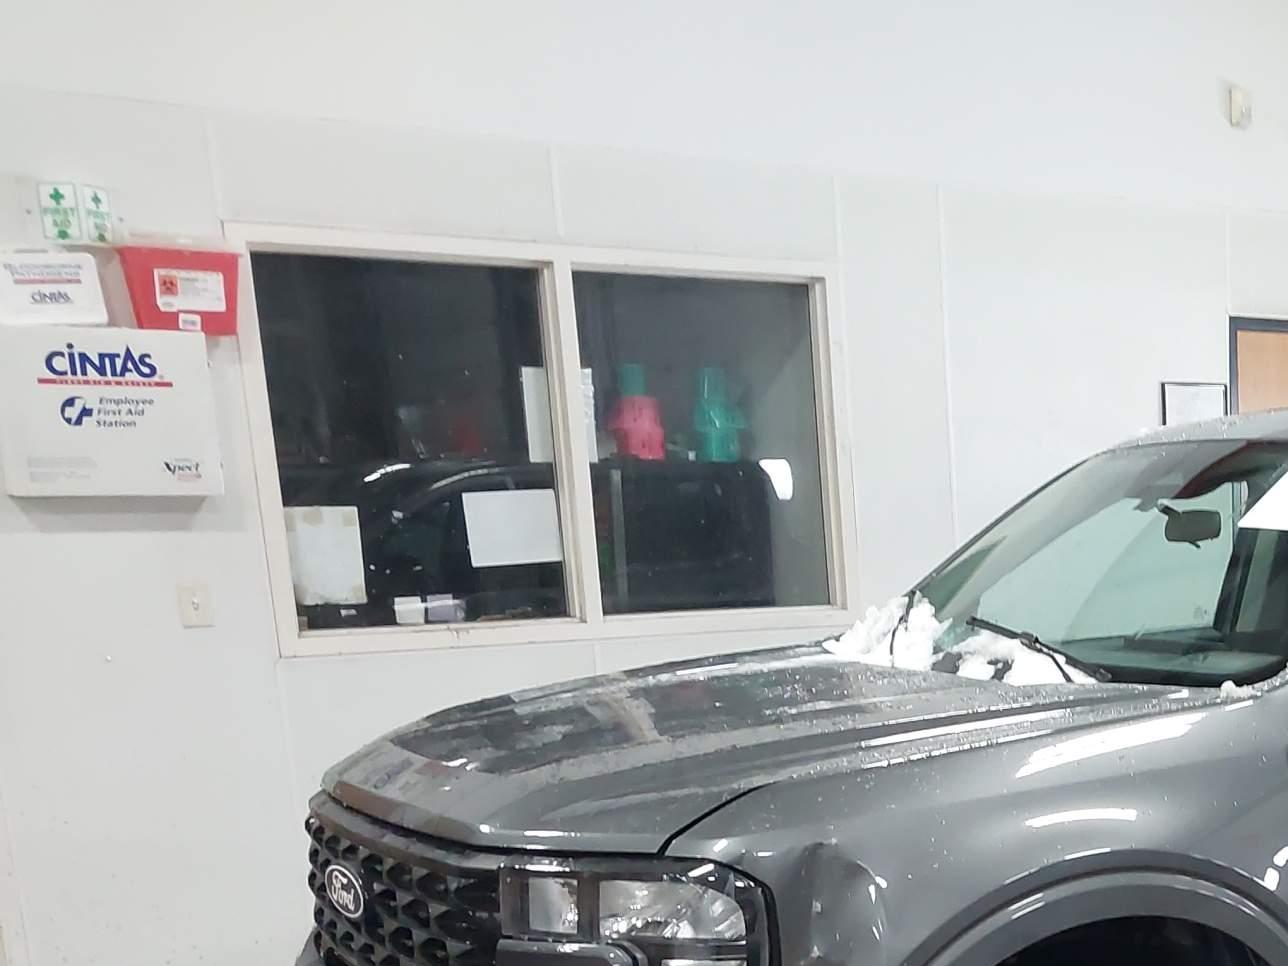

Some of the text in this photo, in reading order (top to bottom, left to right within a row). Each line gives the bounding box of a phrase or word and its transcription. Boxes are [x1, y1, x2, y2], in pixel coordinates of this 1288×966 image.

[98, 396, 155, 407] Employee
[97, 407, 145, 417] First Aid
[96, 419, 137, 428] Station
[332, 870, 355, 911] Ford
